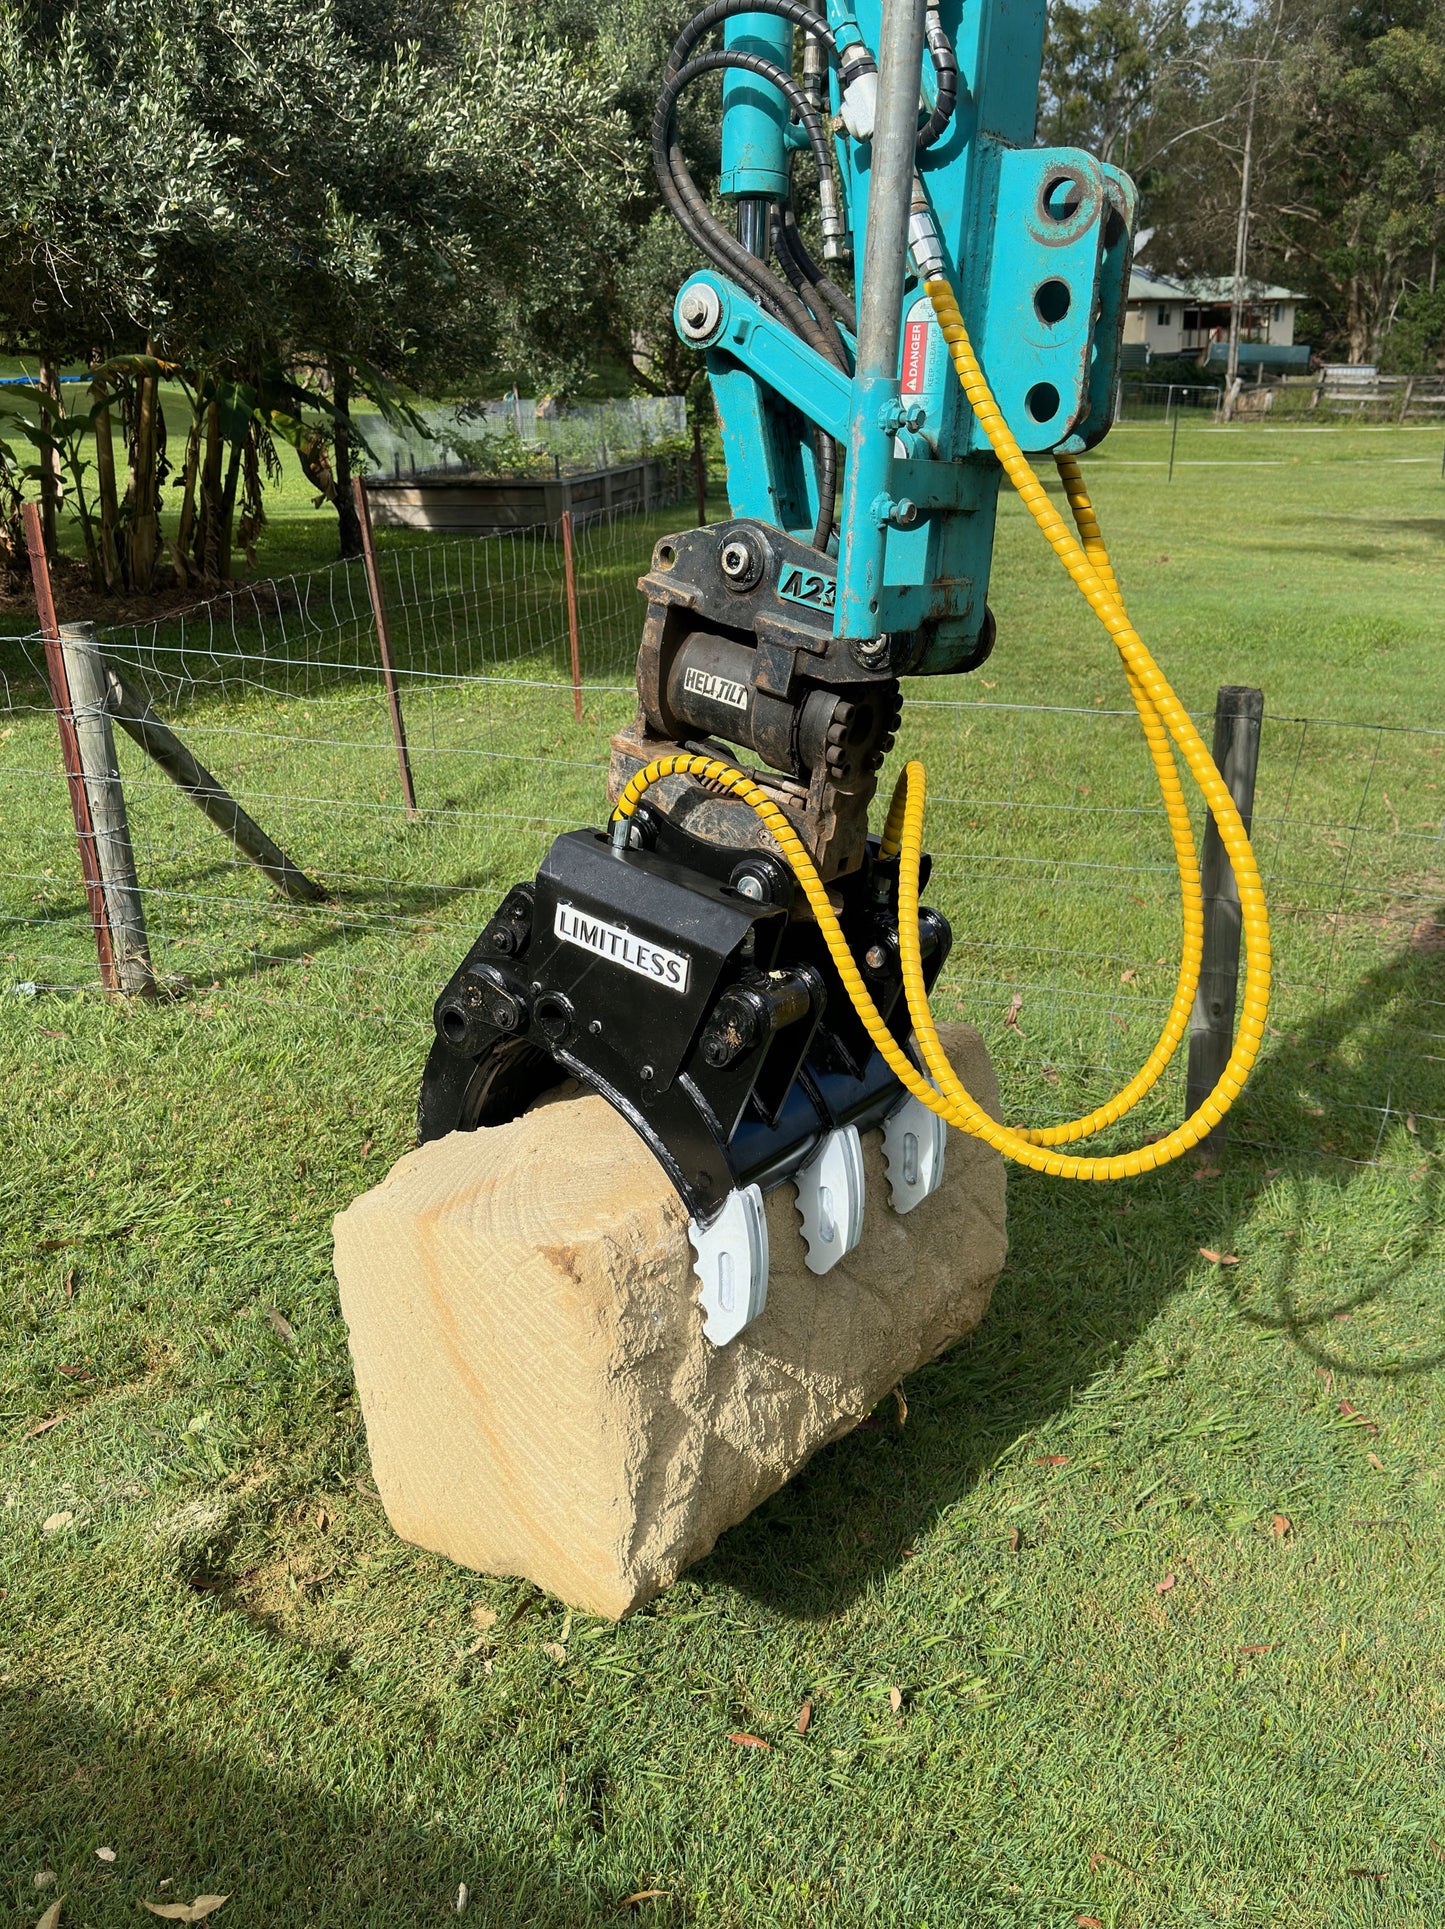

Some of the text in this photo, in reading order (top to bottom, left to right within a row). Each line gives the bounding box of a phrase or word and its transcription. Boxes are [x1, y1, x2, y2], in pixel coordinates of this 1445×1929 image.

[909, 324, 921, 377] DANGER
[932, 328, 938, 338] OF
[559, 910, 681, 984] LIMITLESS
